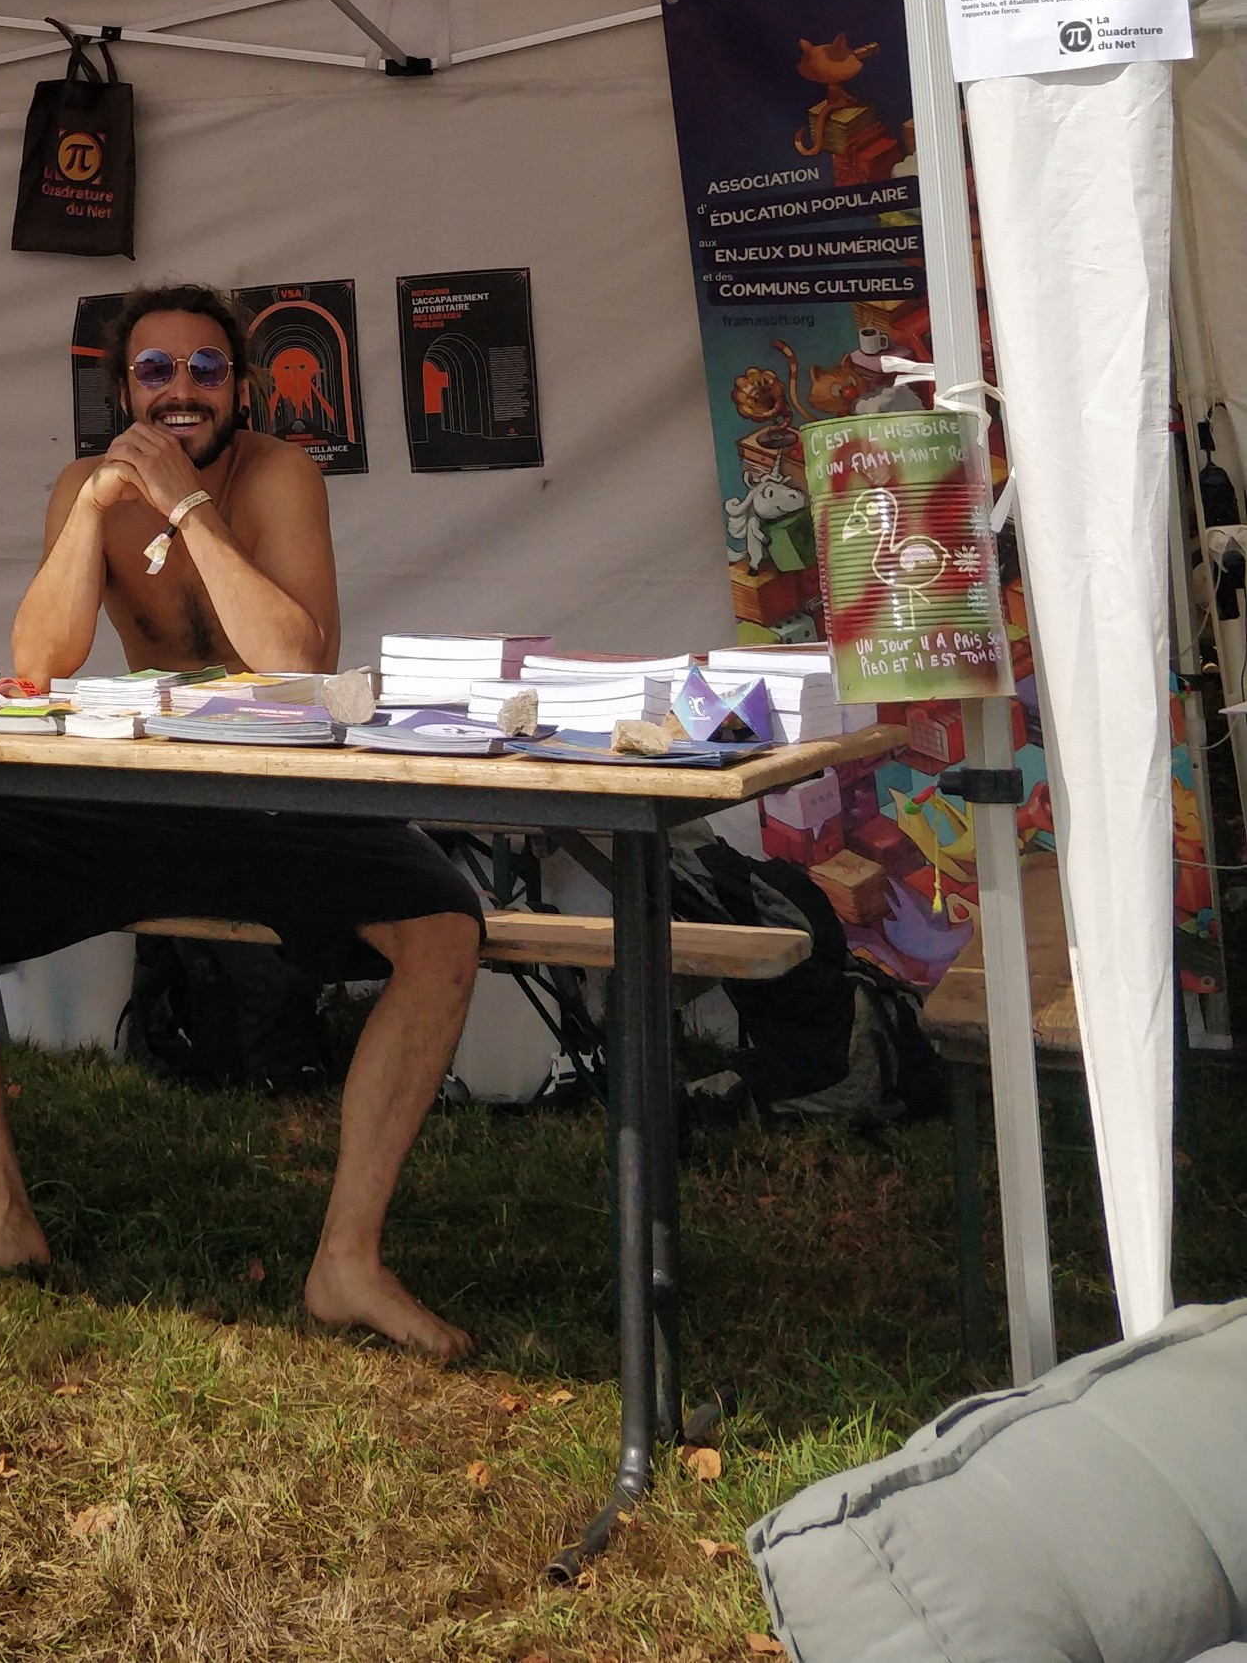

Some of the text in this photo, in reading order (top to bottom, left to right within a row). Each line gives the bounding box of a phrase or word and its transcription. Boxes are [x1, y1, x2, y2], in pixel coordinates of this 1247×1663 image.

[1096, 16, 1109, 24] La
[1098, 26, 1163, 37] Quadrature
[1098, 40, 1136, 50] du Net
[707, 167, 819, 195] ASSOCIATION
[66, 203, 84, 215] du
[710, 202, 808, 227] ÉDUCATION
[811, 186, 909, 212] POPULAIRE
[715, 245, 784, 262] ENJEUX
[789, 244, 813, 259] DU
[817, 236, 918, 256] NUMÉRIQUE
[703, 272, 914, 297] et des COMMUNS CULTURELS
[280, 289, 302, 298] VSA
[412, 293, 489, 305] L'ACCAPAREMENT
[413, 303, 470, 314] AUTORITAIRE
[723, 314, 814, 327] framasoft.org
[811, 428, 853, 455] C'EST
[856, 639, 872, 655] UN
[936, 632, 946, 649] A
[893, 658, 909, 672] ET
[931, 653, 956, 667] EST
